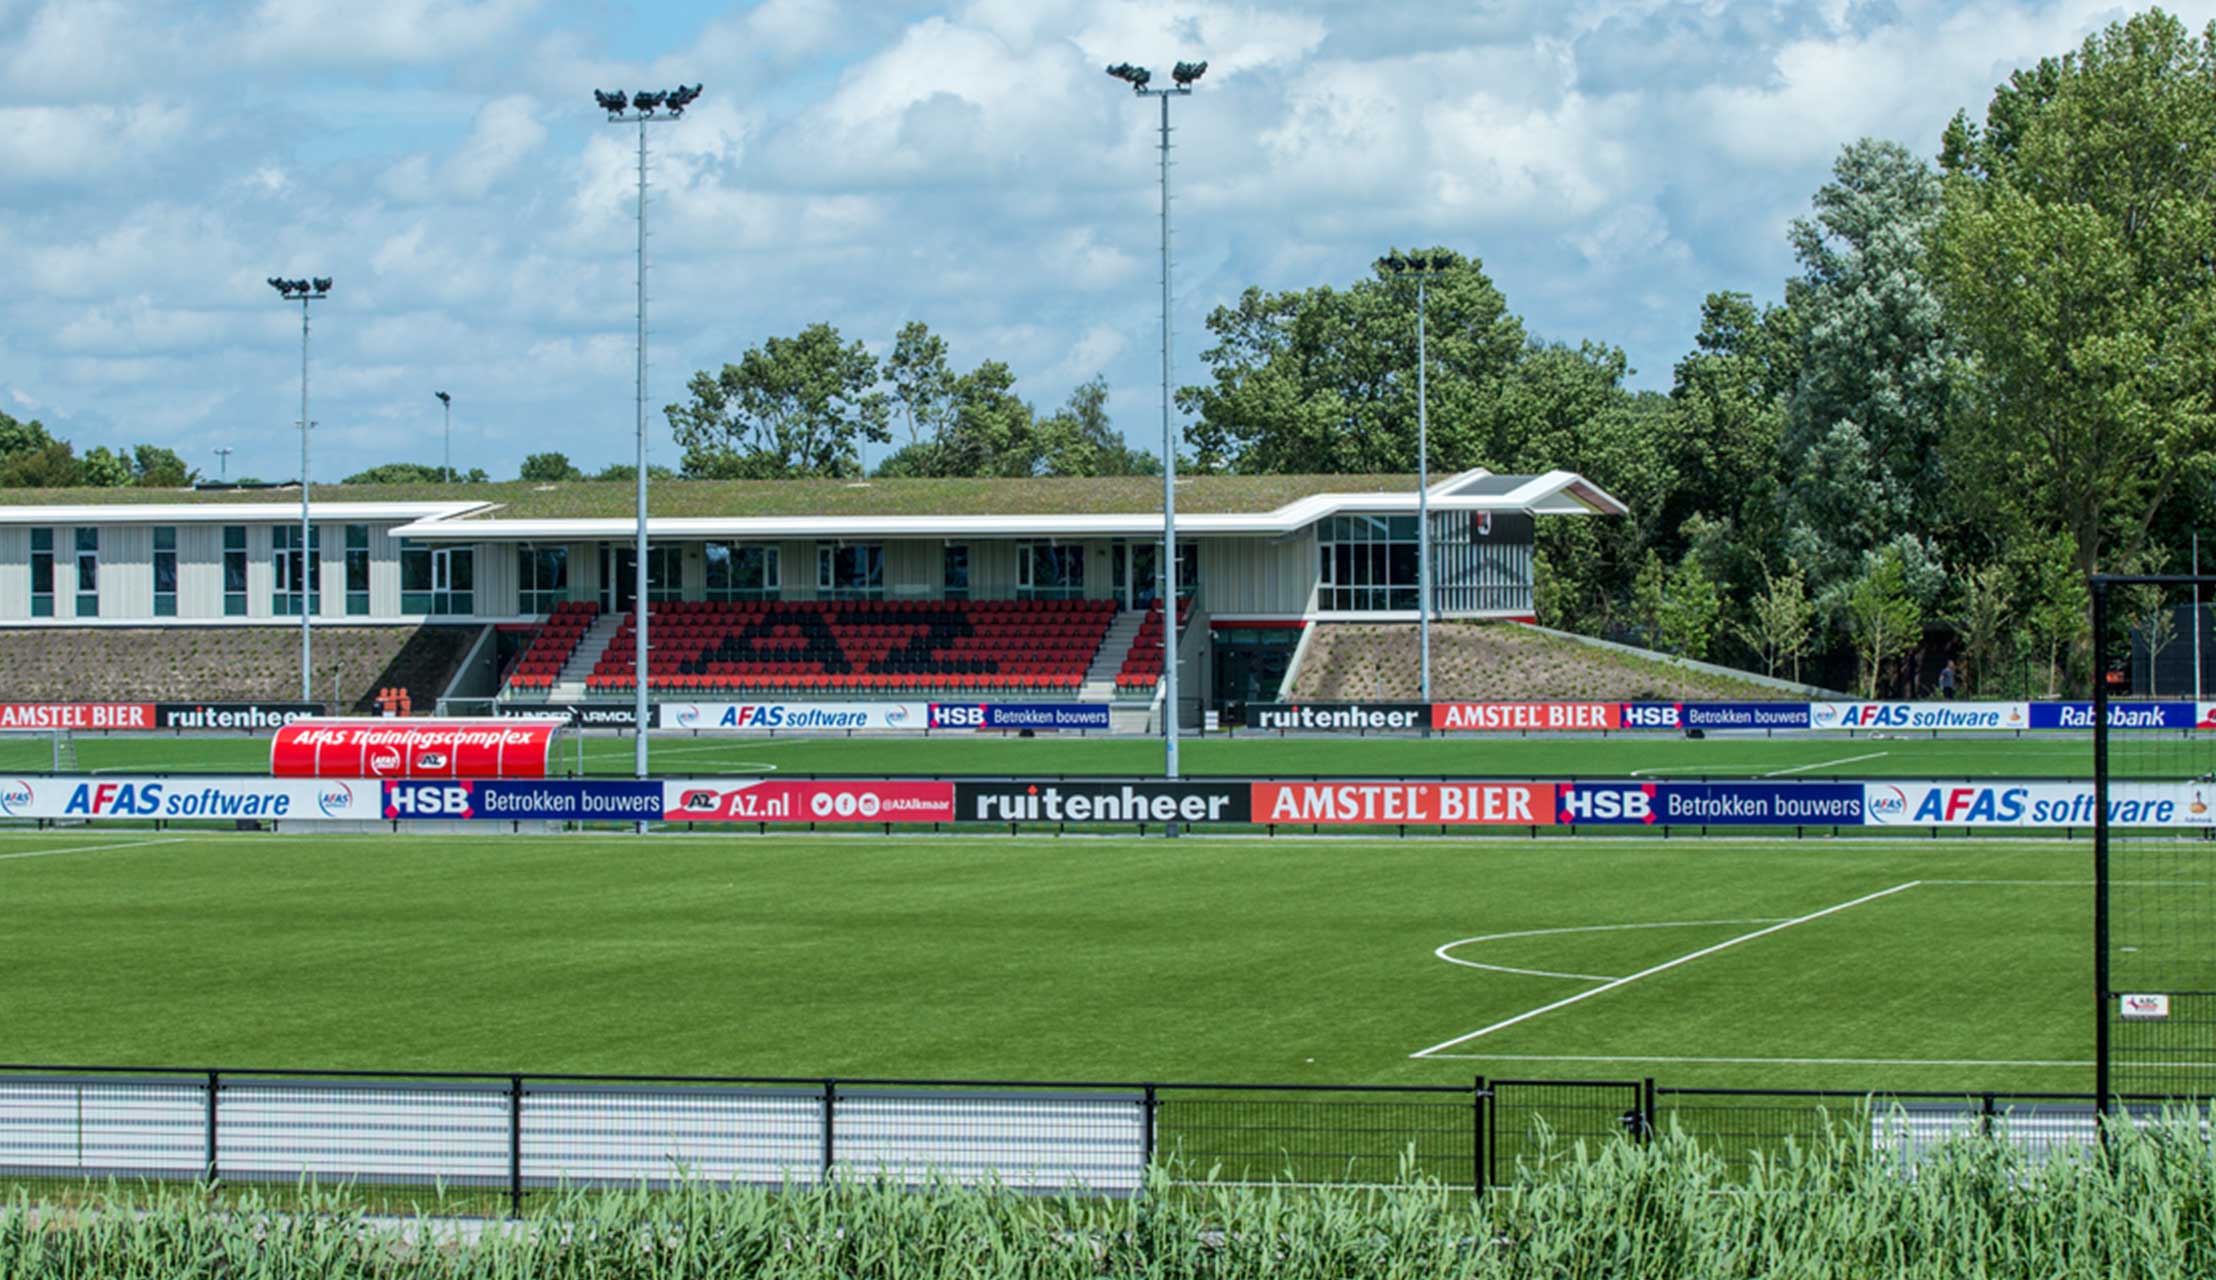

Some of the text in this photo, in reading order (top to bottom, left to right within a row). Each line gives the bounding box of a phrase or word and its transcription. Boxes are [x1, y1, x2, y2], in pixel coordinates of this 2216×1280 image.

[680, 611, 998, 674] AZ
[92, 705, 145, 726] BIER
[720, 706, 868, 727] AFAS software
[934, 707, 1108, 724] HSB Betrokken bouwers
[1259, 705, 1419, 727] ruitenheer
[1549, 705, 1607, 726] BIER
[1626, 707, 1808, 724] HSB Betrokken bouwers
[1841, 705, 1999, 726] AFAS software
[2059, 706, 2166, 726] Rabbank
[292, 729, 349, 745] AFAS
[64, 784, 291, 814] AFAS software
[391, 787, 661, 814] HSB Betrokken bouwers
[685, 793, 716, 808] AZ
[729, 792, 789, 816] AZ.nl
[882, 799, 950, 811] @AZAlkmaar
[976, 785, 1230, 820] ruitenheer
[1439, 787, 1534, 820] BIER
[1565, 790, 1861, 818] HSB Betrokken bouwers
[1913, 788, 2028, 822] AFAS
